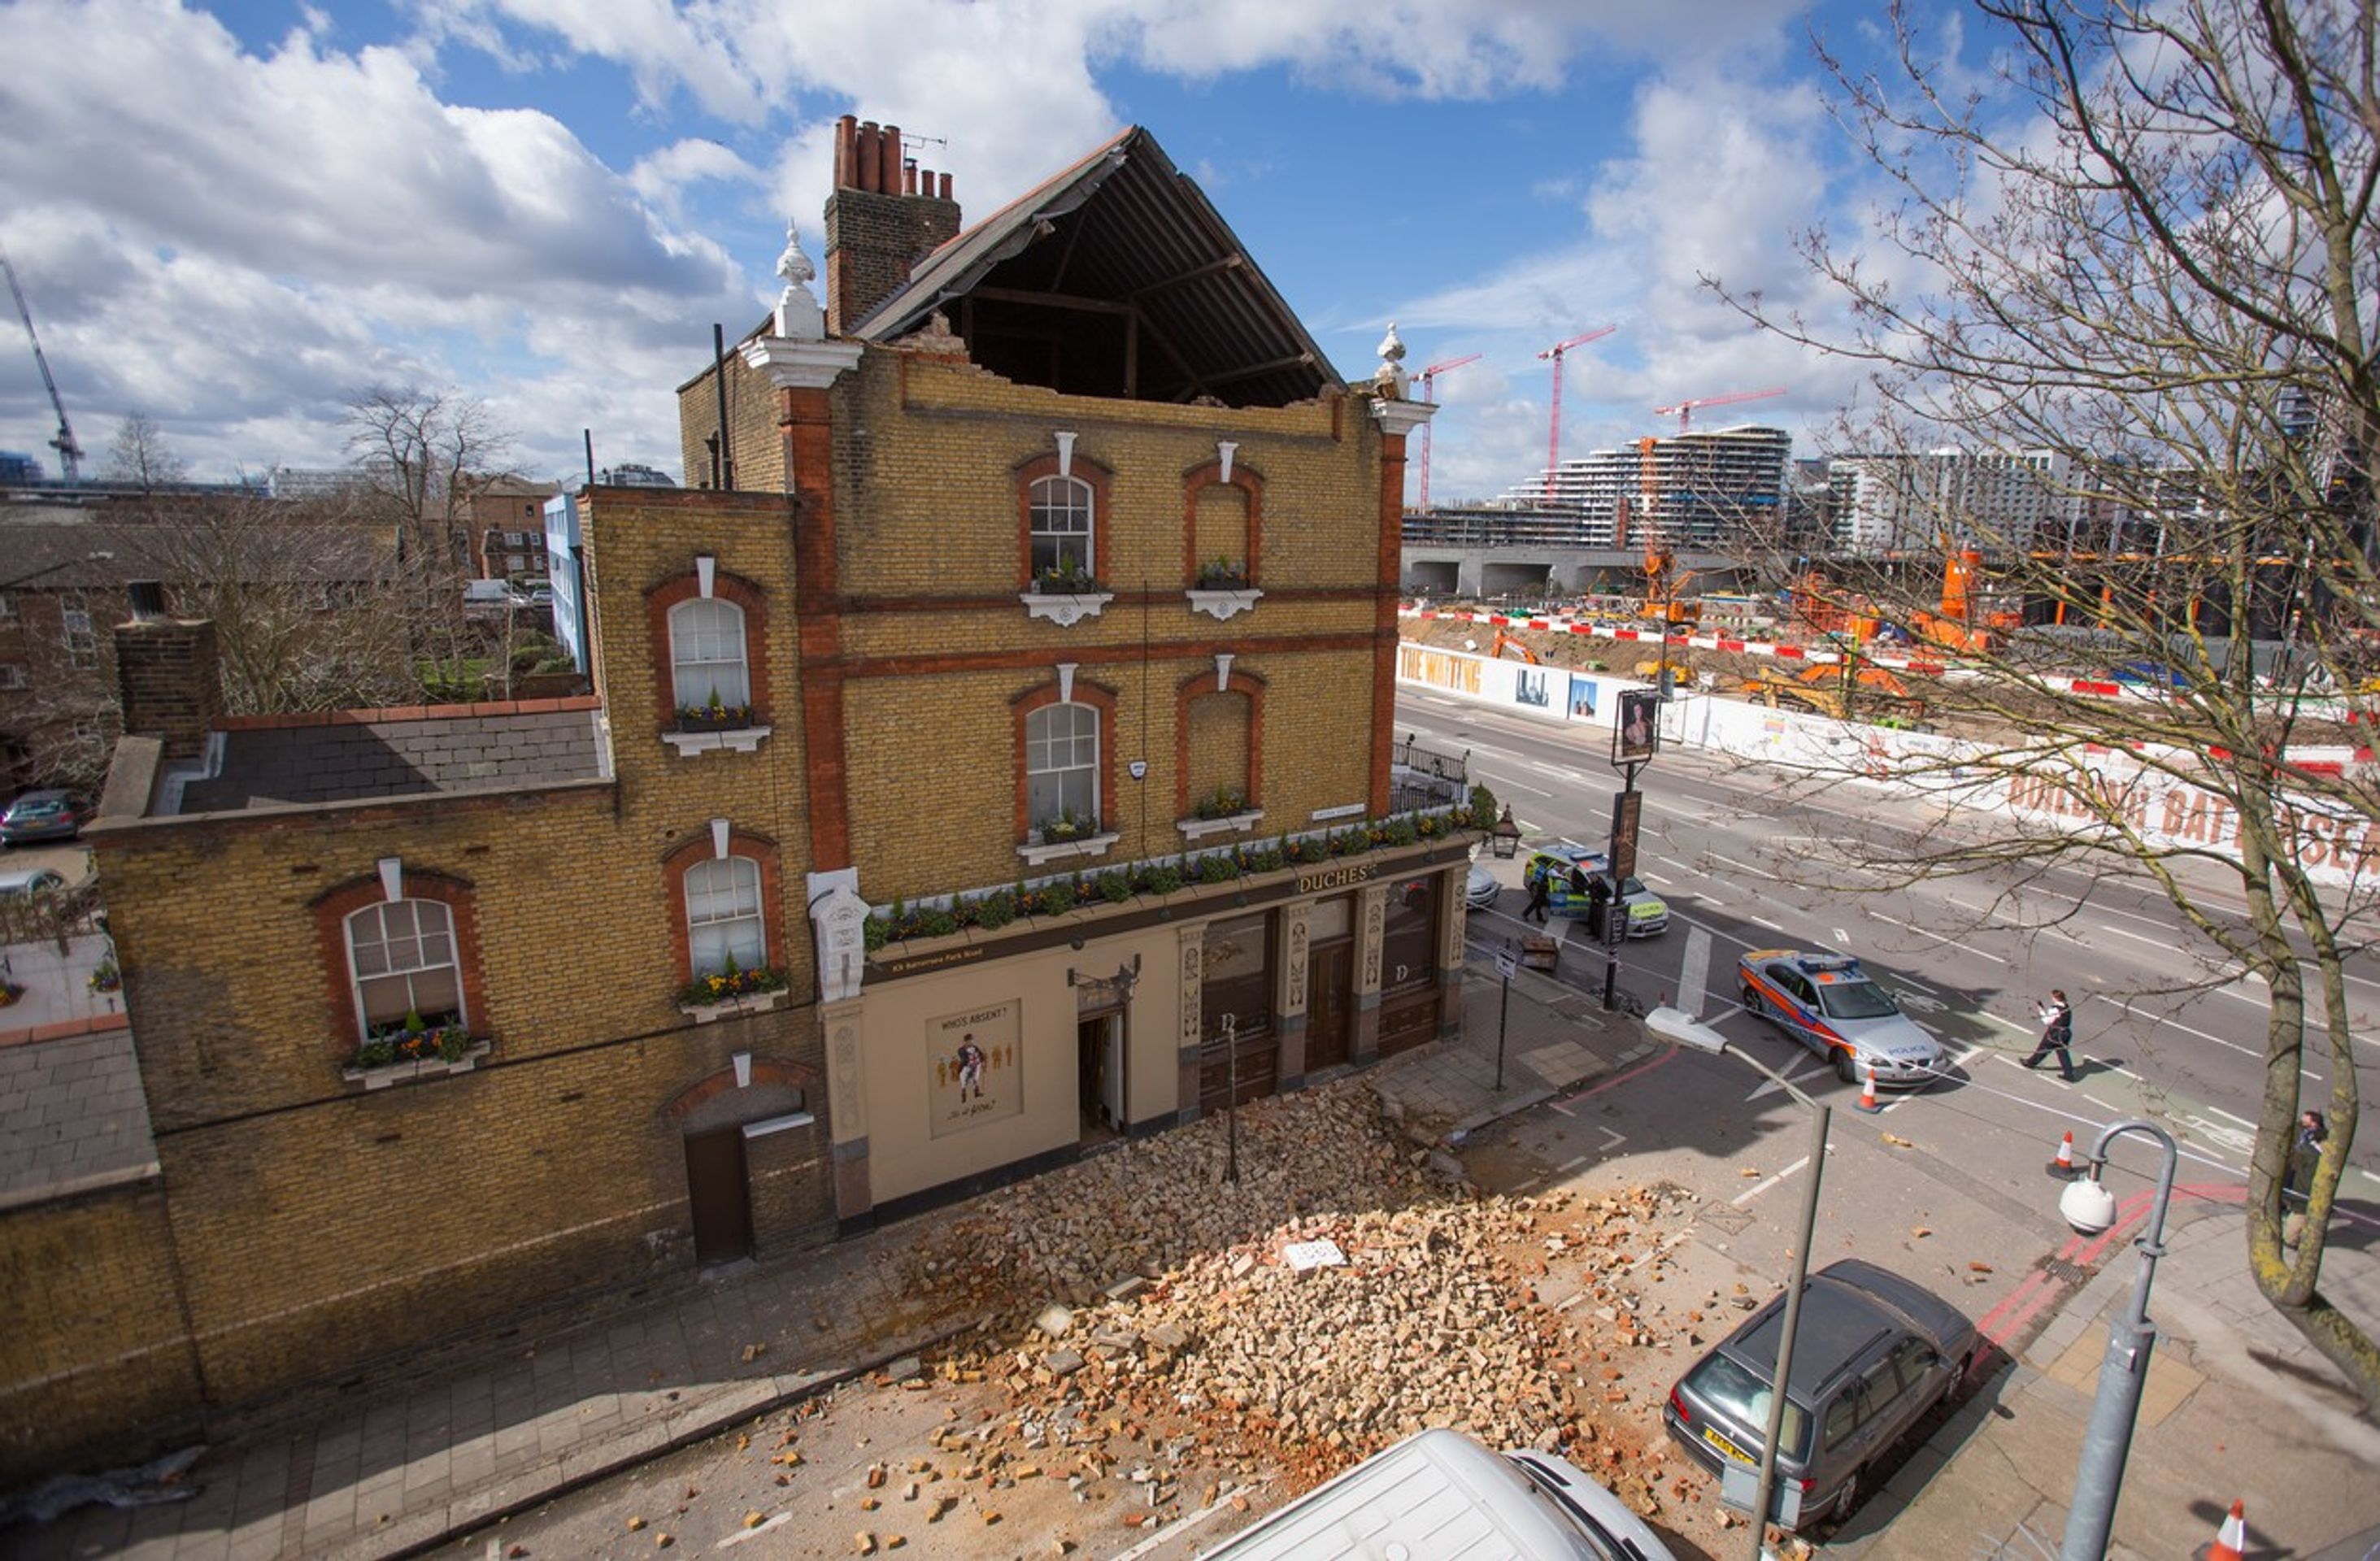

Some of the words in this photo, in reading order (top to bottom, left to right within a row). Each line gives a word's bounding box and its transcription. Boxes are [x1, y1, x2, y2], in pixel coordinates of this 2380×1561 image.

[1401, 646, 1421, 680] THE
[1425, 652, 1482, 694] WAITING
[1300, 864, 1377, 893] DUCHES
[1395, 965, 1408, 981] D
[942, 1016, 968, 1030] WHO'S
[1888, 1045, 1927, 1055] POLICE
